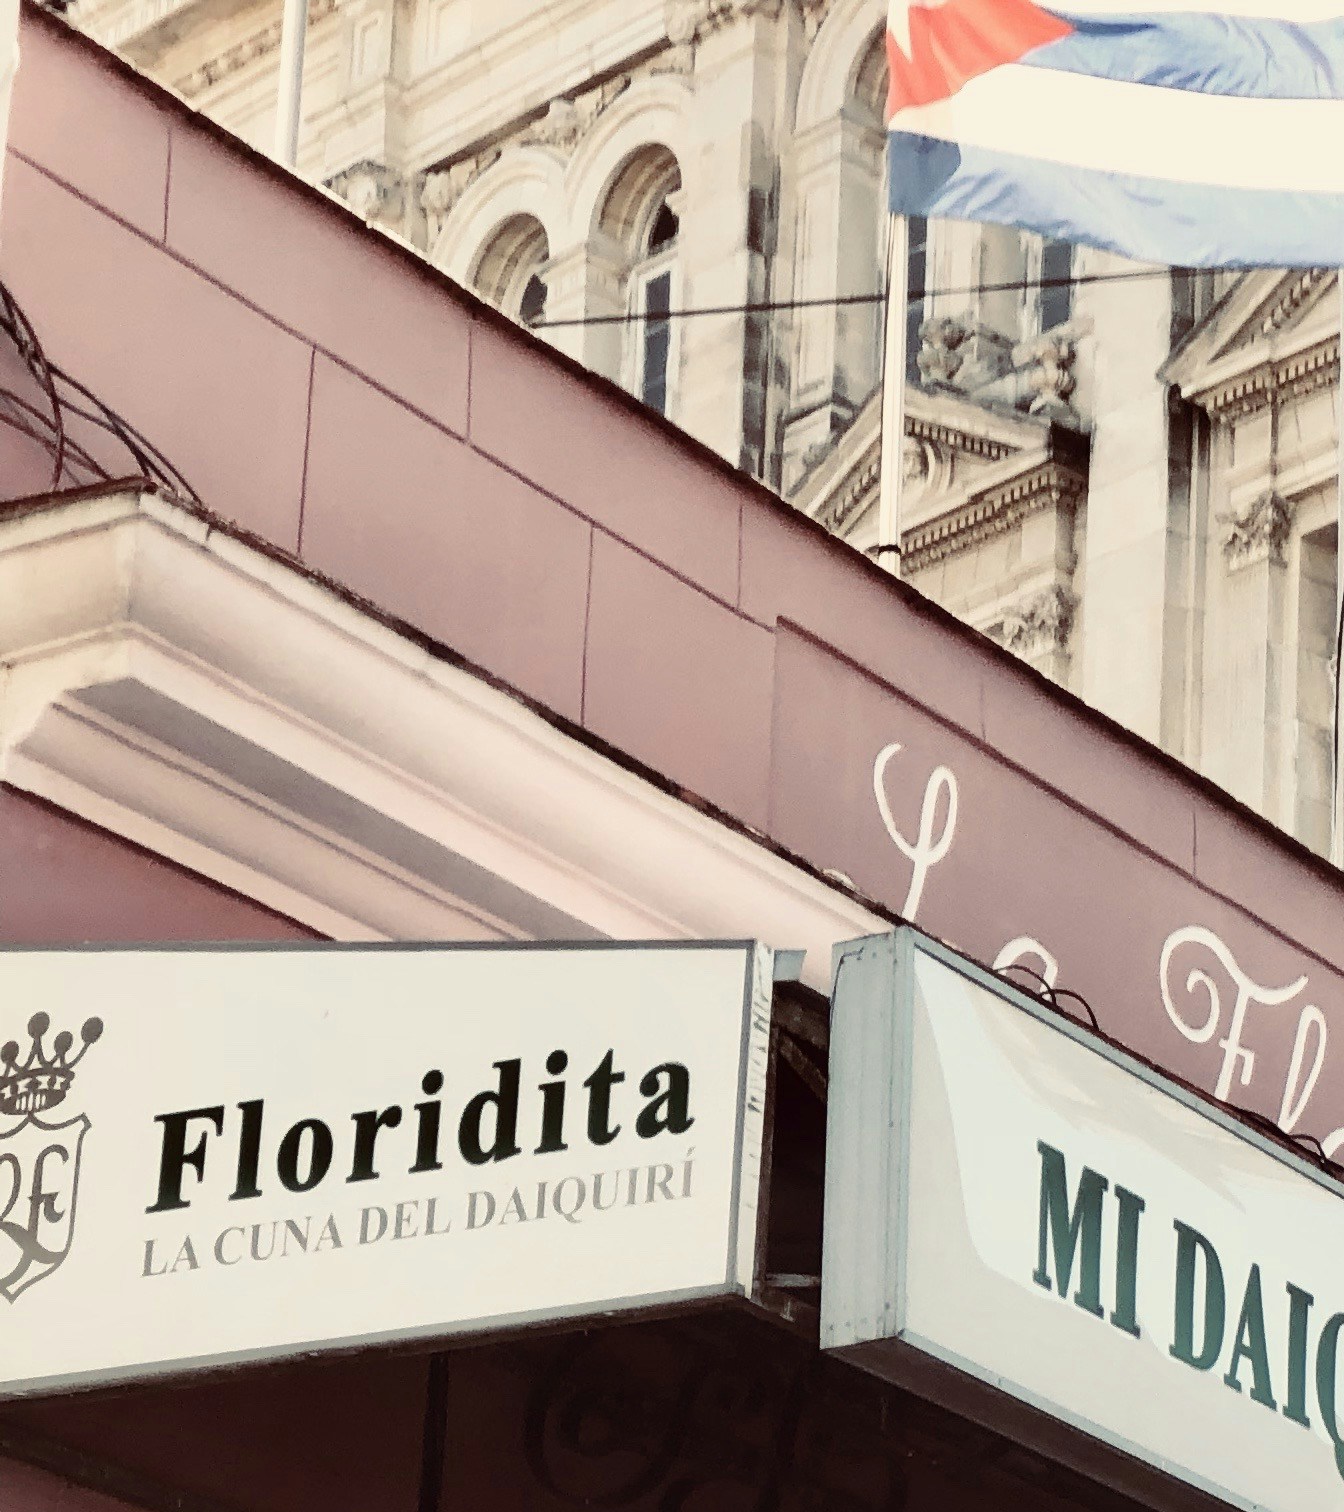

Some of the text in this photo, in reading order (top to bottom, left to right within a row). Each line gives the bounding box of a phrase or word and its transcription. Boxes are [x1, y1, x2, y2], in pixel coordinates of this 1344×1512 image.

[141, 1146, 696, 1277] LA CUNA DEL DAIQUIRÍ
[145, 1048, 695, 1214] Floridita
[1032, 1139, 1146, 1340] MI
